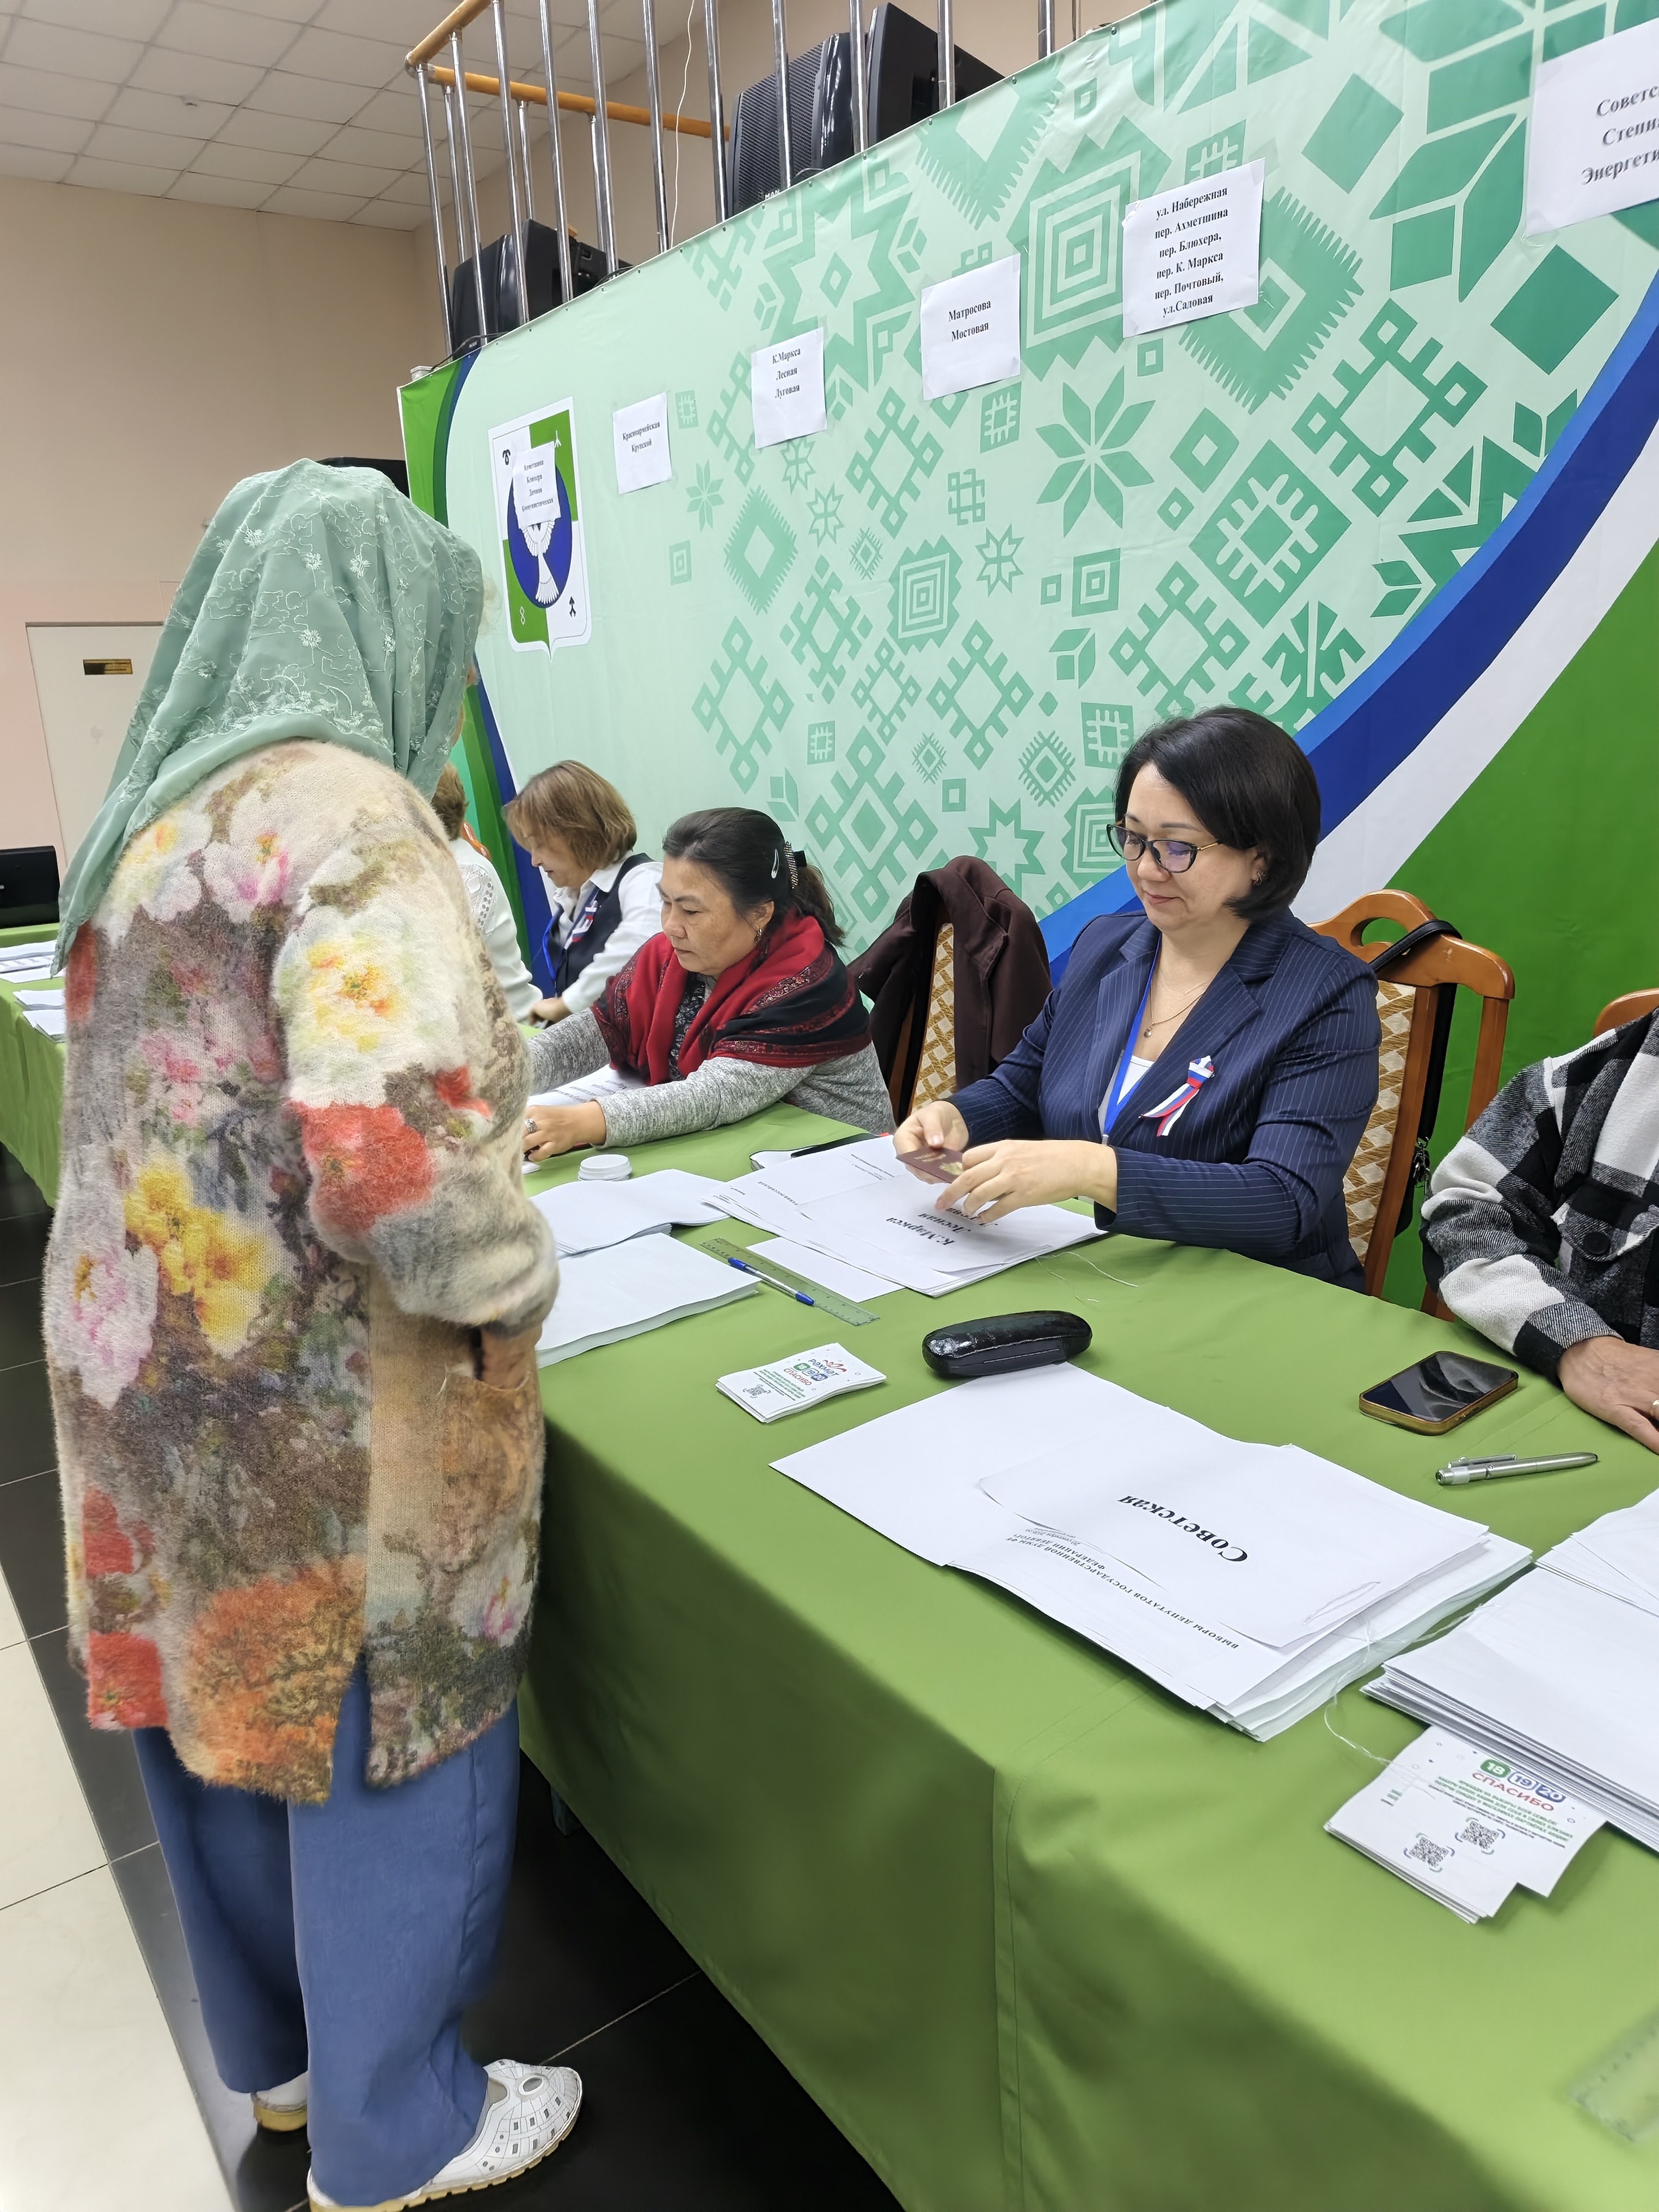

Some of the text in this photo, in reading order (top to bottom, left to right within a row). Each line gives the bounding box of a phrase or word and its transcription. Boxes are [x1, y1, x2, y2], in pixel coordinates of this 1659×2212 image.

[1596, 85, 1659, 116] Советс
[1602, 117, 1659, 146] Степн
[1156, 187, 1227, 220] ул. Набережная
[1155, 208, 1228, 239] пер. Ахметшина
[1159, 232, 1222, 258] пер. Блюхера,
[1157, 252, 1223, 279] пер. К. Маркса
[1155, 272, 1224, 300] пер. Почтовый,
[949, 300, 991, 322] Матросова
[1163, 294, 1213, 317] ул.Садовая
[951, 322, 988, 341] Мостовая
[772, 348, 801, 364] К.Маркса
[776, 367, 797, 380] Лесная
[775, 384, 800, 399] Луговая
[623, 421, 660, 441] Красноармейская
[631, 438, 652, 453] Крупской
[886, 1217, 955, 1245] К.Маркса
[918, 1213, 971, 1233] Лесная
[784, 1368, 812, 1386] СПАСИБО
[1117, 1495, 1248, 1562] Советская
[1044, 1546, 1133, 1594] ГОСУДАРСТВЕННОЙ
[1053, 1543, 1105, 1570] ФЕДЕРАЦИИ
[1134, 1593, 1194, 1625] ДЕПУТАТОВ
[1193, 1624, 1239, 1649] ВЫБОРЫ
[1472, 1772, 1554, 1811] СПАСИБО
[1486, 1762, 1506, 1775] 18
[1514, 1775, 1532, 1786] 19
[1540, 1787, 1563, 1801] 20
